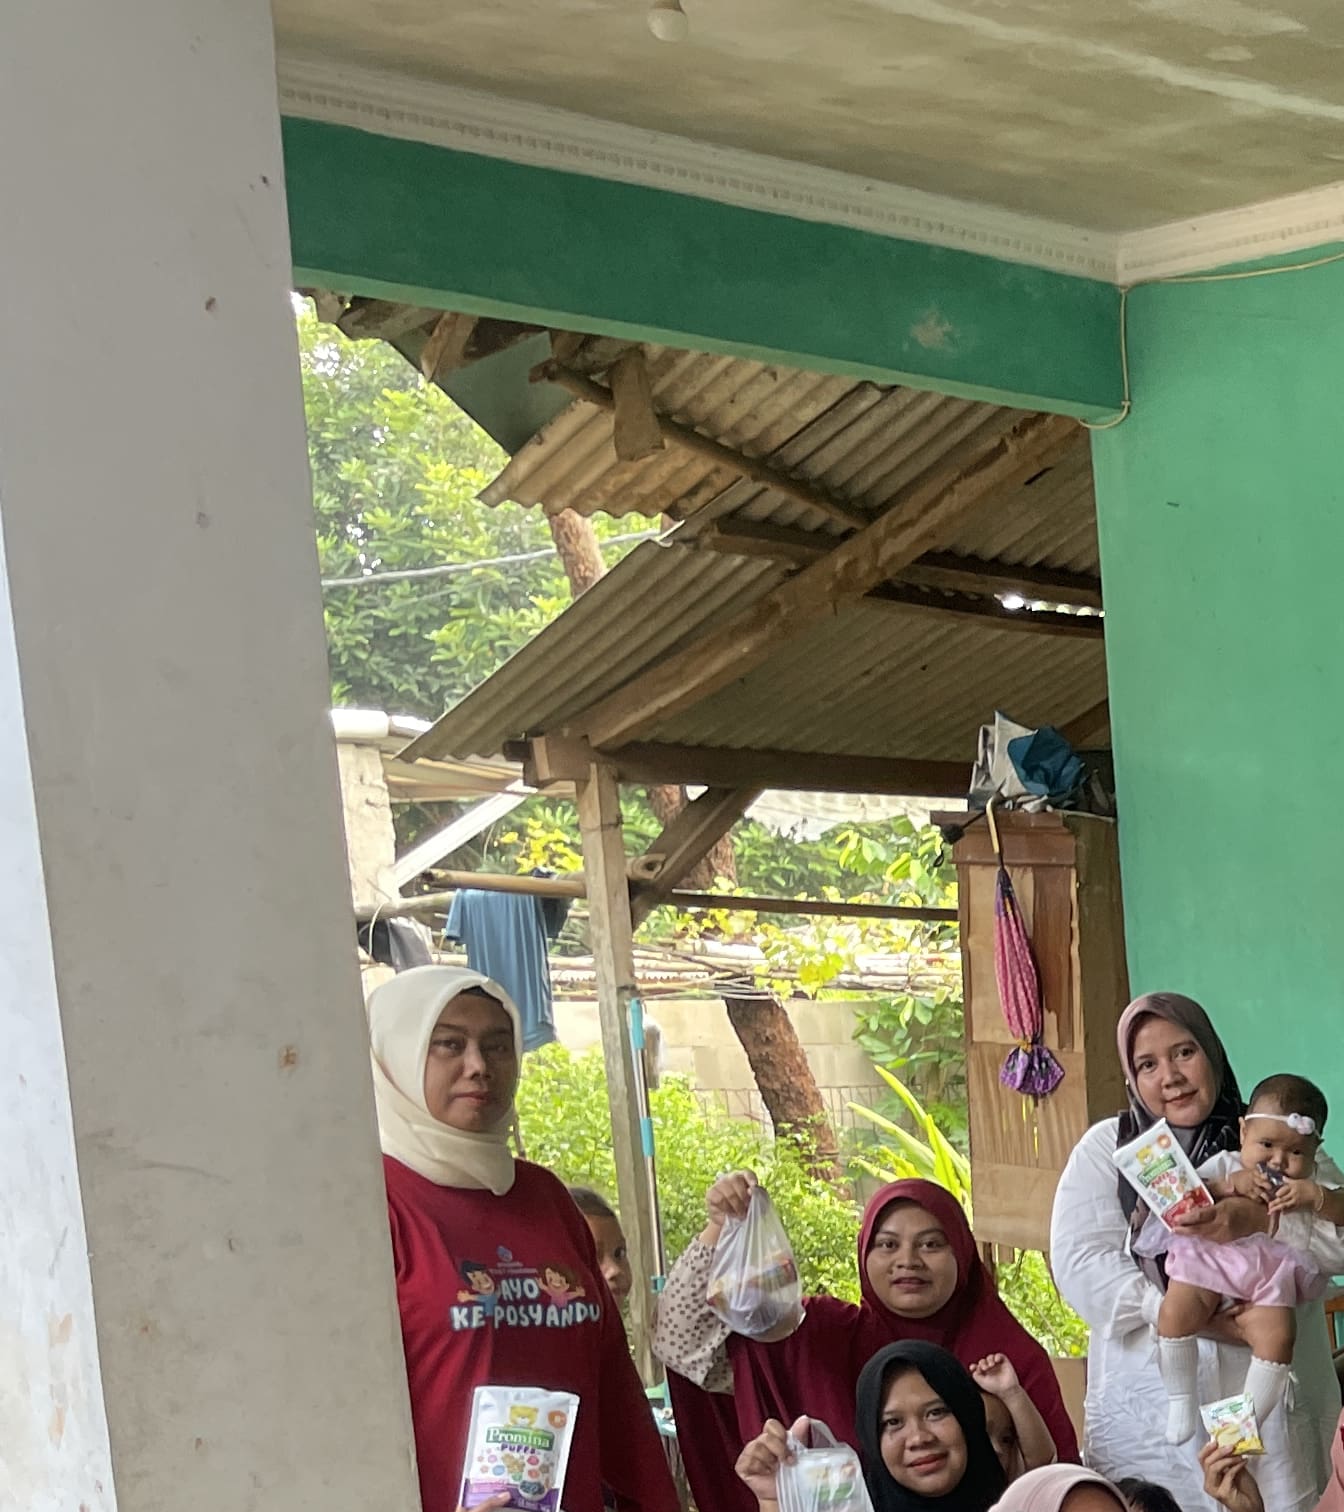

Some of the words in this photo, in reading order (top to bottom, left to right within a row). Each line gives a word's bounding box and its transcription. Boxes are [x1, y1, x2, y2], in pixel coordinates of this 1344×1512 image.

[501, 1278, 539, 1300] AYO
[450, 1304, 485, 1331] KE
[494, 1301, 601, 1329] POSYANDU
[488, 1428, 550, 1448] Promina
